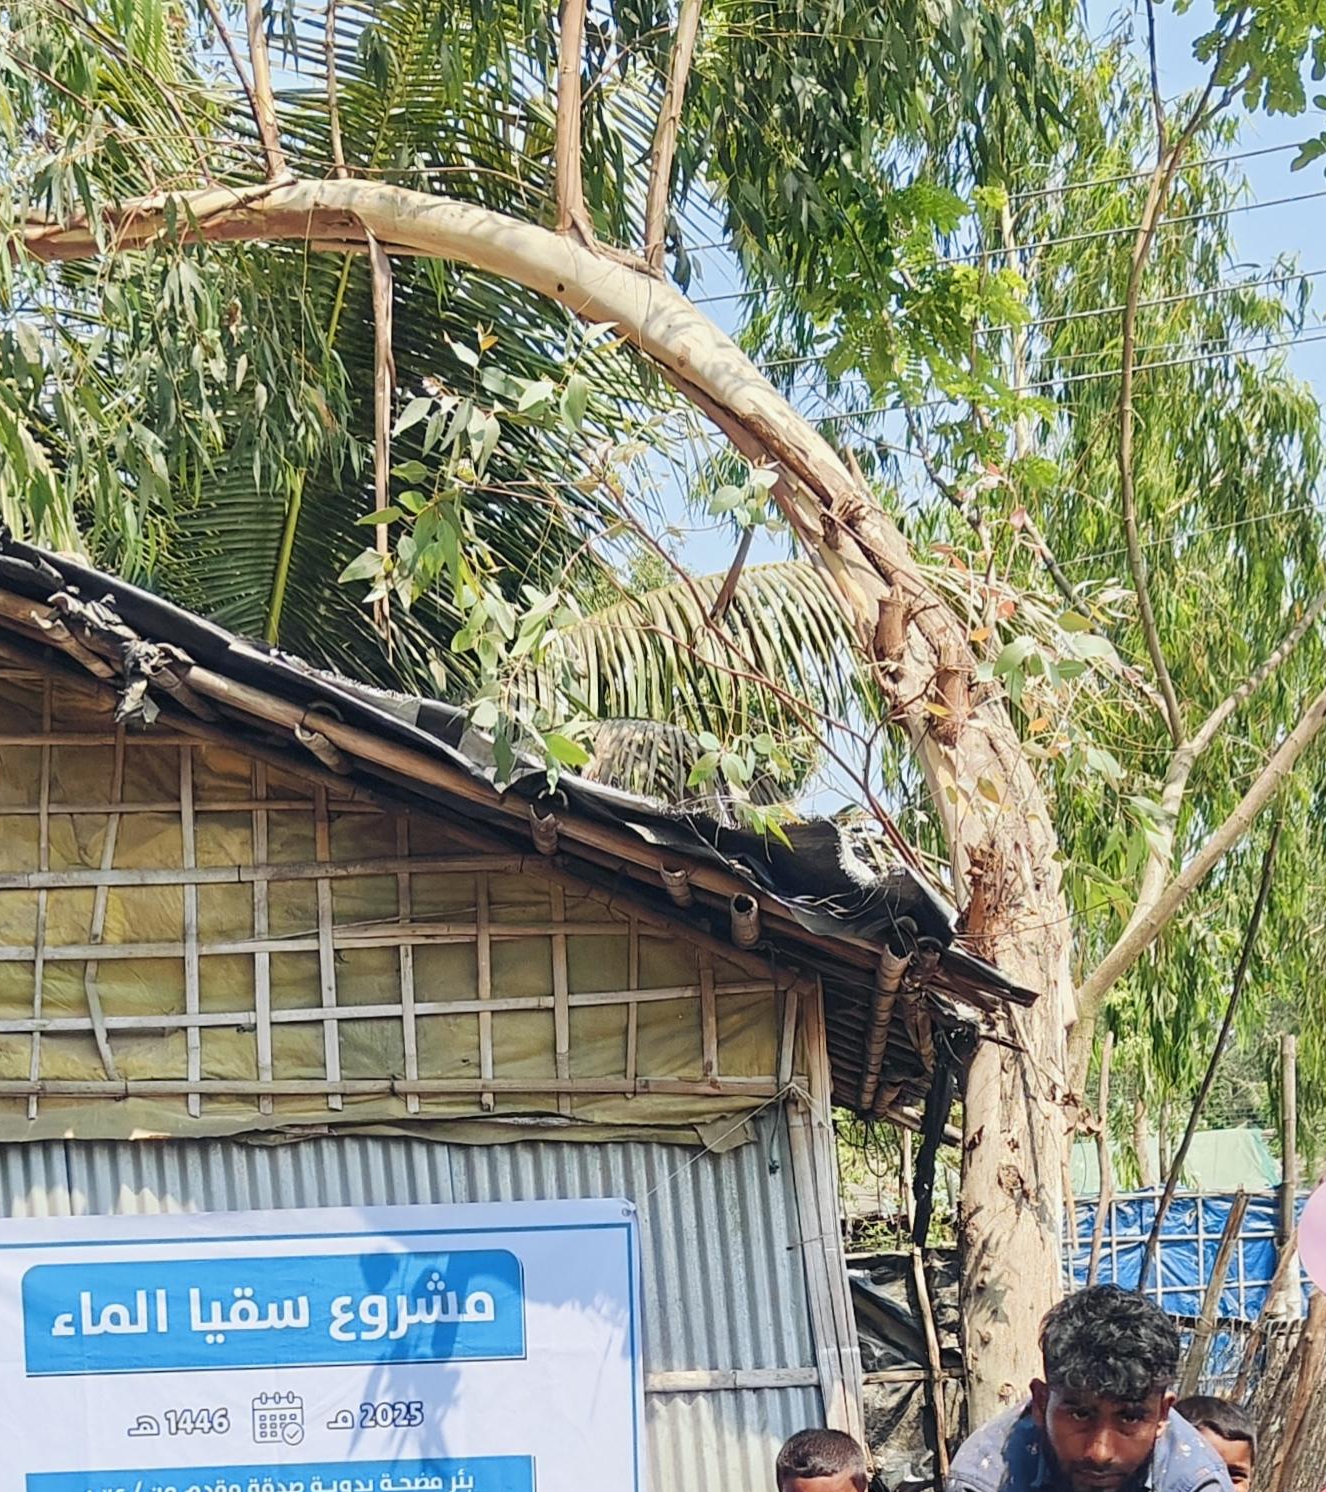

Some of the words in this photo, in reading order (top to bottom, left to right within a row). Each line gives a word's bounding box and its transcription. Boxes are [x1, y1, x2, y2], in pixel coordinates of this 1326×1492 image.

[51, 1288, 168, 1336] الماء
[189, 1287, 310, 1345] سقيا
[329, 1272, 495, 1342] مشروع
[165, 1407, 230, 1435] 1446
[359, 1401, 424, 1429] 2025
